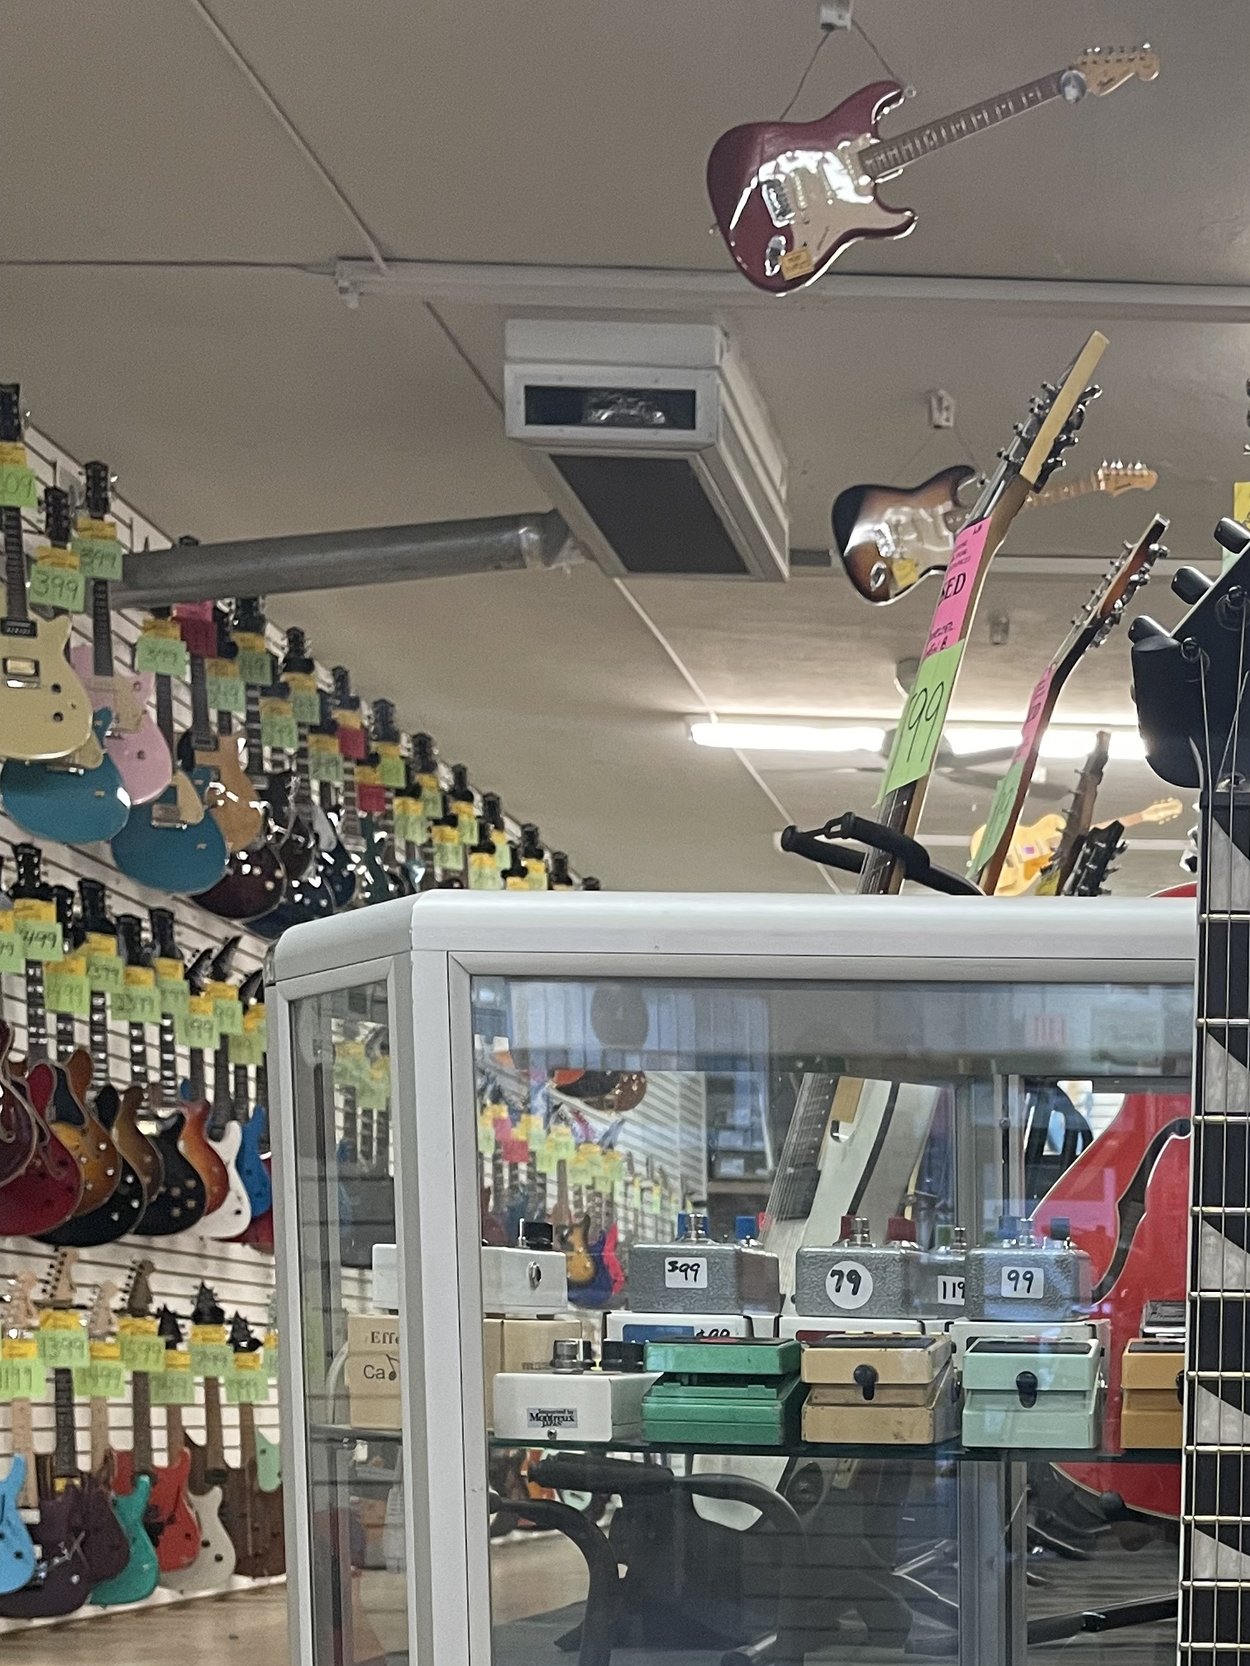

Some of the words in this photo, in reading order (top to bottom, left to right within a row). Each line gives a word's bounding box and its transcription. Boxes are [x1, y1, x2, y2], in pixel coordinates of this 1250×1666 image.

[830, 1269, 862, 1296] 79
[942, 1280, 965, 1300] 119
[1007, 1269, 1034, 1294] 99
